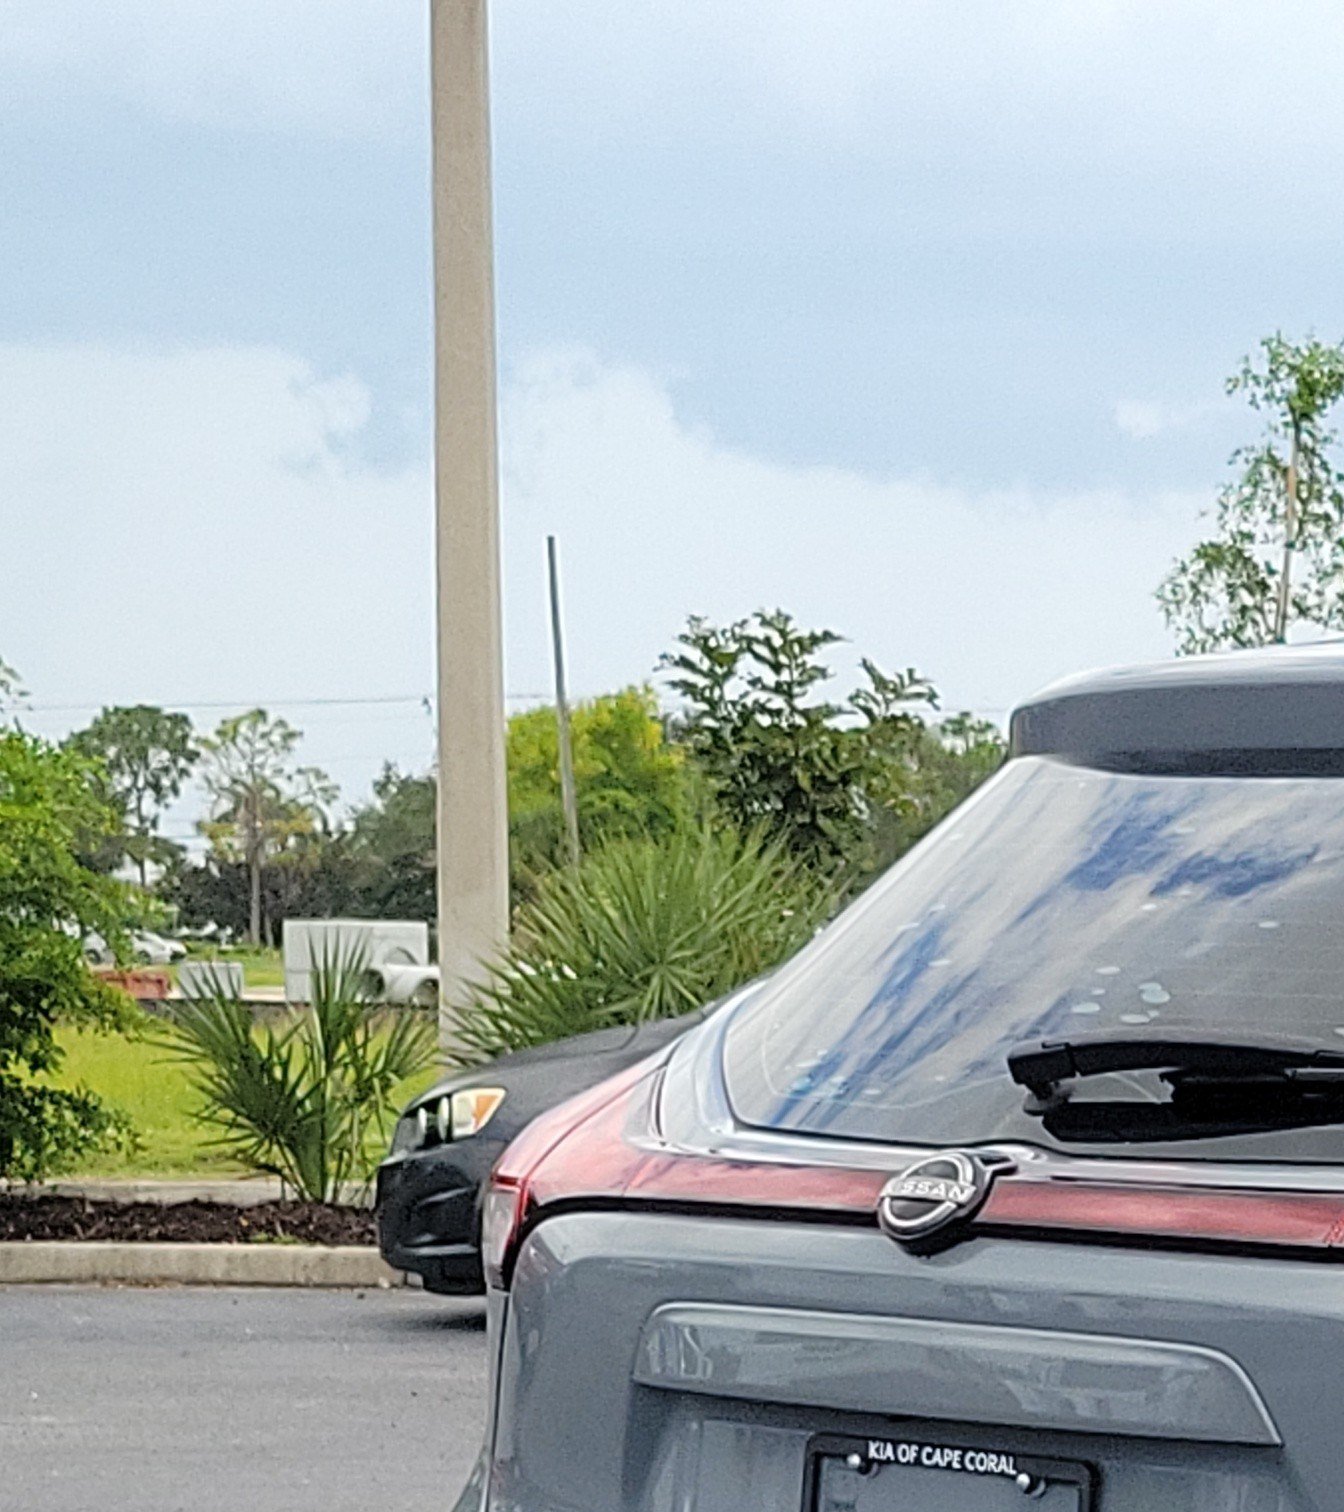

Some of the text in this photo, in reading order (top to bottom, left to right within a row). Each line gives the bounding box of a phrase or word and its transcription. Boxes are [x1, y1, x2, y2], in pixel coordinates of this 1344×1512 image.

[888, 1177, 974, 1202] SSAN
[868, 1440, 1018, 1475] KIA OF CAPE CORAL
